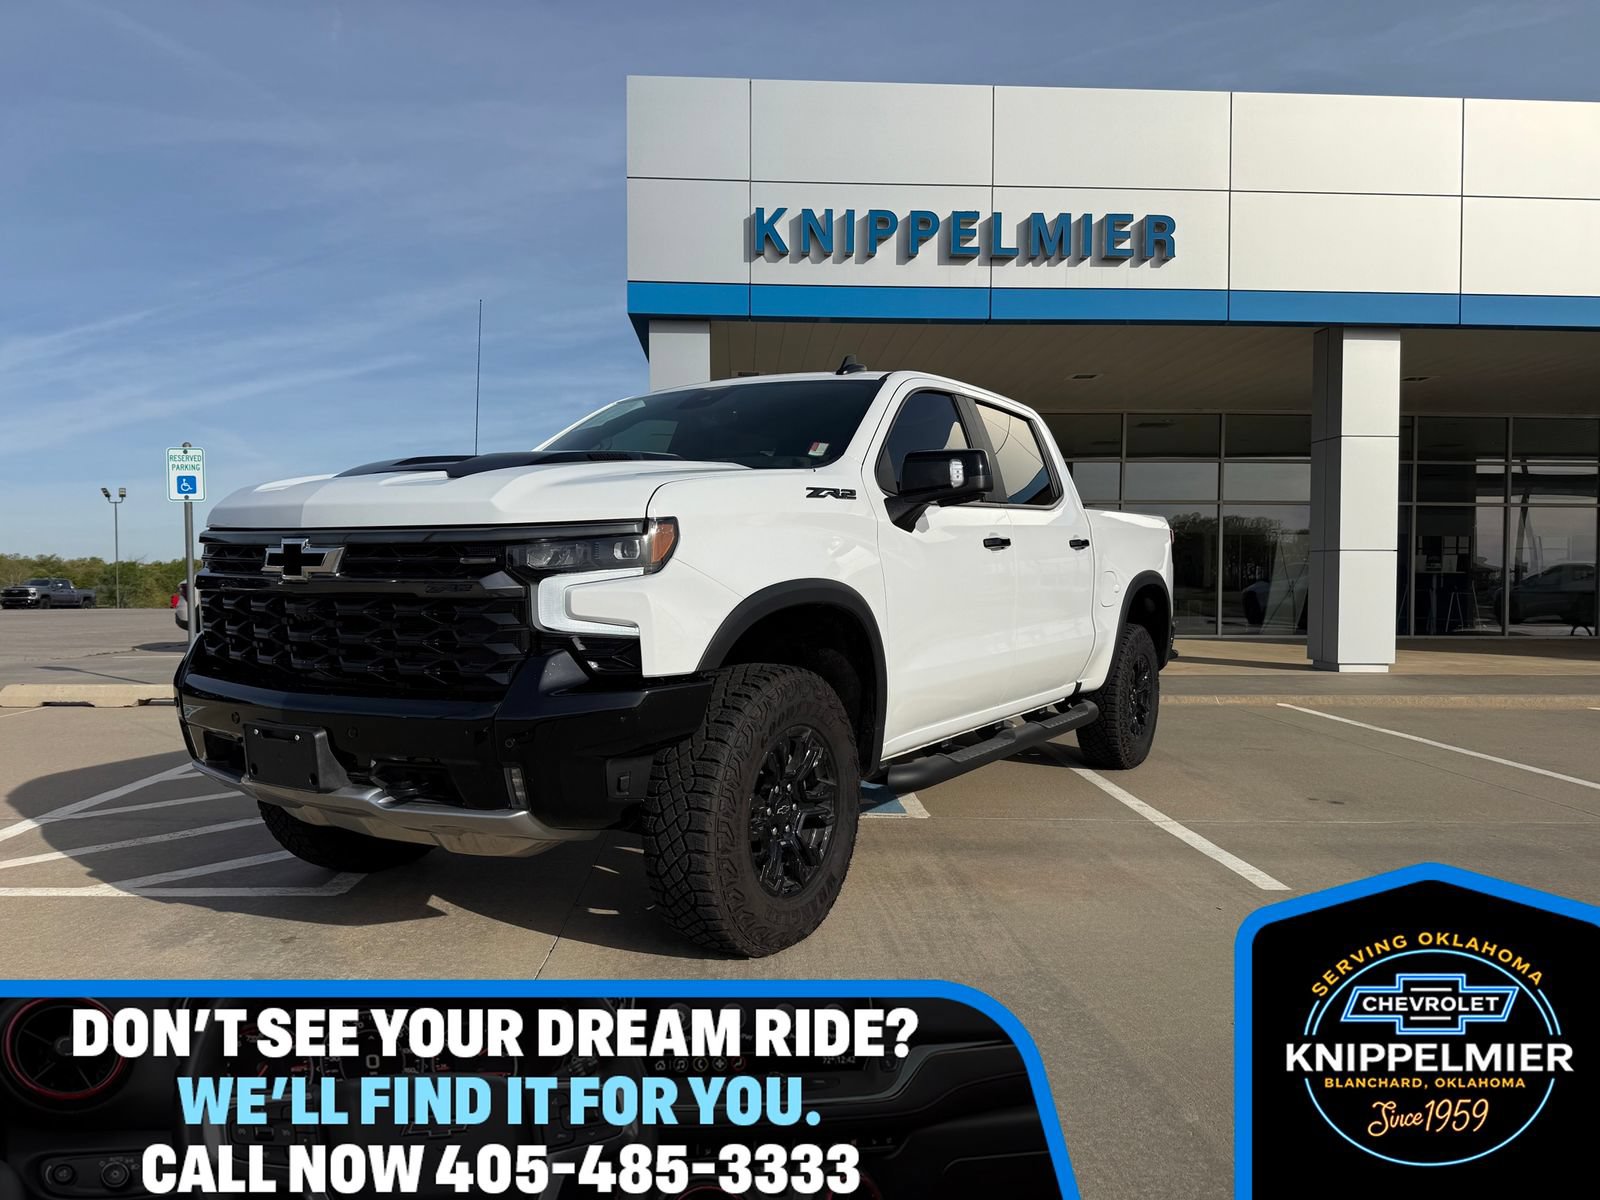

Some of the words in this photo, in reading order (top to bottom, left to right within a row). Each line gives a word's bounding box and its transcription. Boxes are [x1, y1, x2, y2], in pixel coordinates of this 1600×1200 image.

[753, 206, 1177, 260] KNIPPELMIER
[169, 454, 202, 462] RESERVED
[171, 463, 201, 472] PARKING
[805, 486, 857, 500] ZR2
